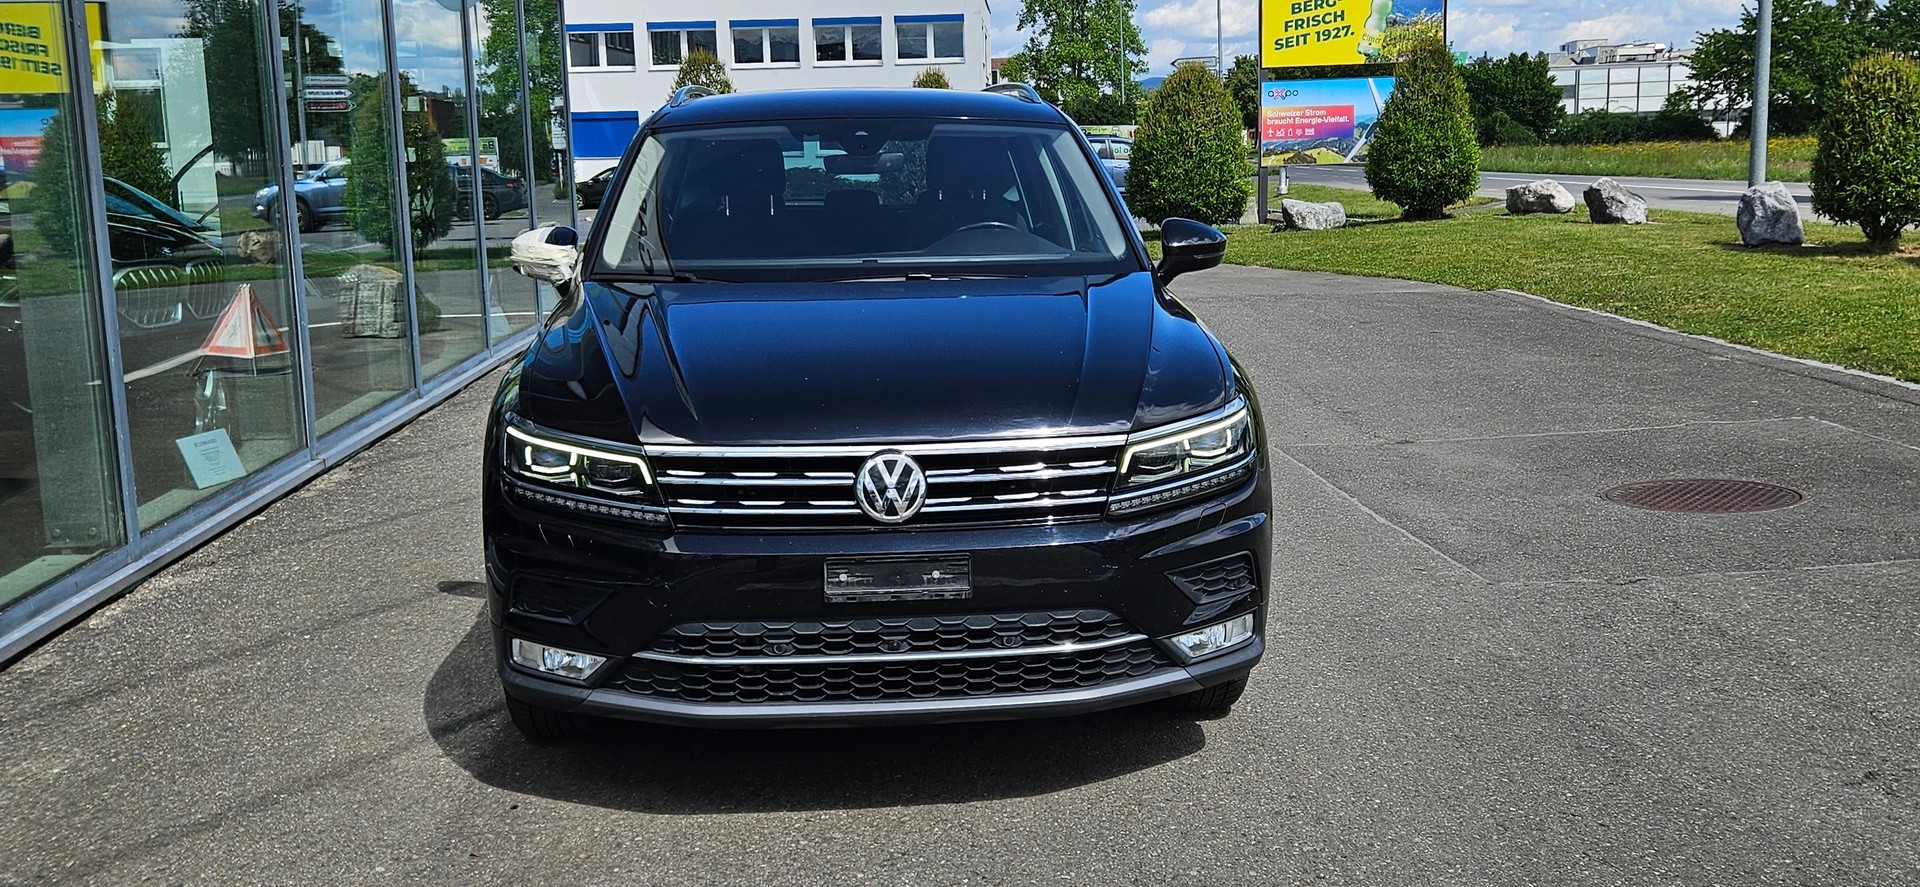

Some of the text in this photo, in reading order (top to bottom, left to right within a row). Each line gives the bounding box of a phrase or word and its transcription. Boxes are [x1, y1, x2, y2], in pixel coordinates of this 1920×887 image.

[1284, 10, 1345, 33] FRISCH
[1274, 25, 1355, 51] SEIT 1927.
[1267, 88, 1299, 100] axpo
[1267, 109, 1304, 117] Schweizer
[1267, 116, 1350, 125] braucht Energie-Vielfalt.
